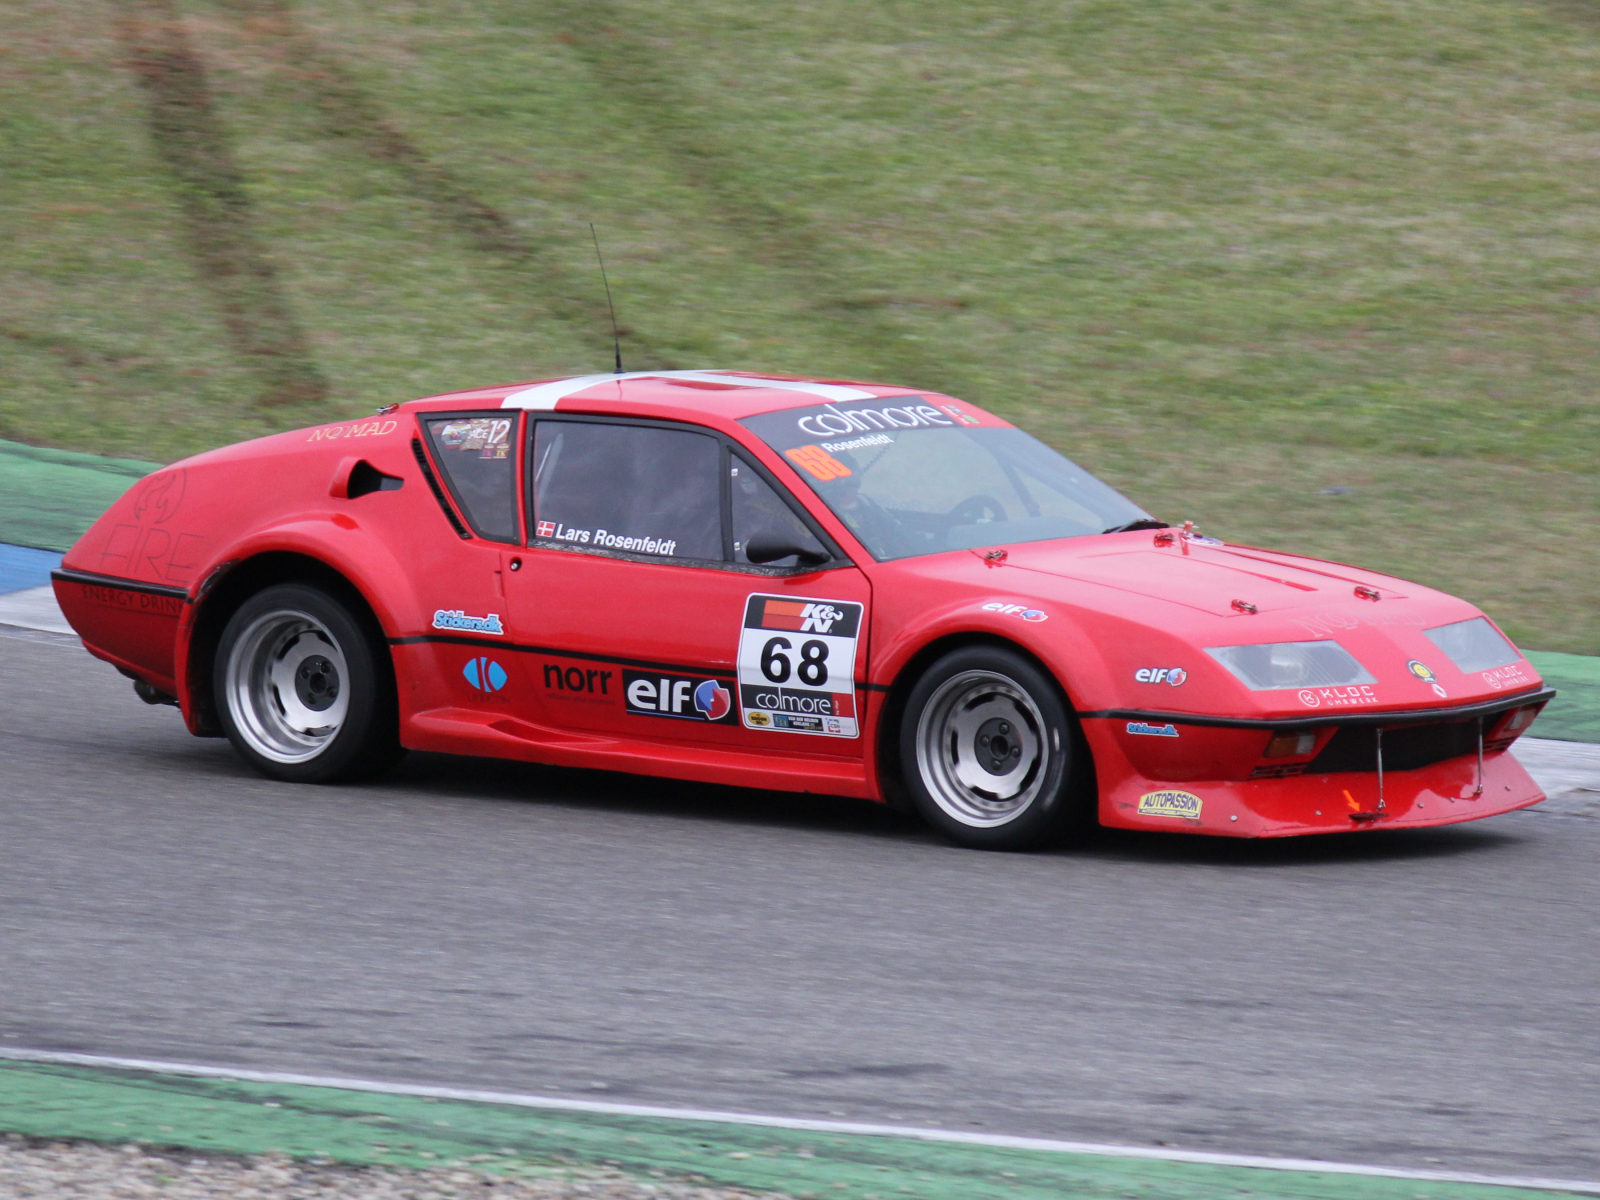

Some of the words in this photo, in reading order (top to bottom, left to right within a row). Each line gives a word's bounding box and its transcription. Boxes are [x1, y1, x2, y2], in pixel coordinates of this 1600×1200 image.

[487, 420, 511, 443] 12
[798, 403, 953, 436] colmore
[821, 433, 894, 453] Rosenfeldt
[785, 445, 852, 481] 68
[555, 523, 590, 543] Lars
[593, 529, 676, 555] Rosenfeldt
[99, 523, 205, 583] FIRE
[81, 584, 136, 606] ENERGY
[981, 601, 1028, 614] elf
[433, 610, 503, 634] Stickers.dk
[760, 636, 830, 687] 68
[543, 663, 613, 695] norr
[1135, 667, 1169, 684] elf
[627, 678, 691, 713] elf
[756, 686, 831, 715] colmore
[1320, 685, 1374, 698] KLOC
[1143, 793, 1199, 811] AUTOPASSION
